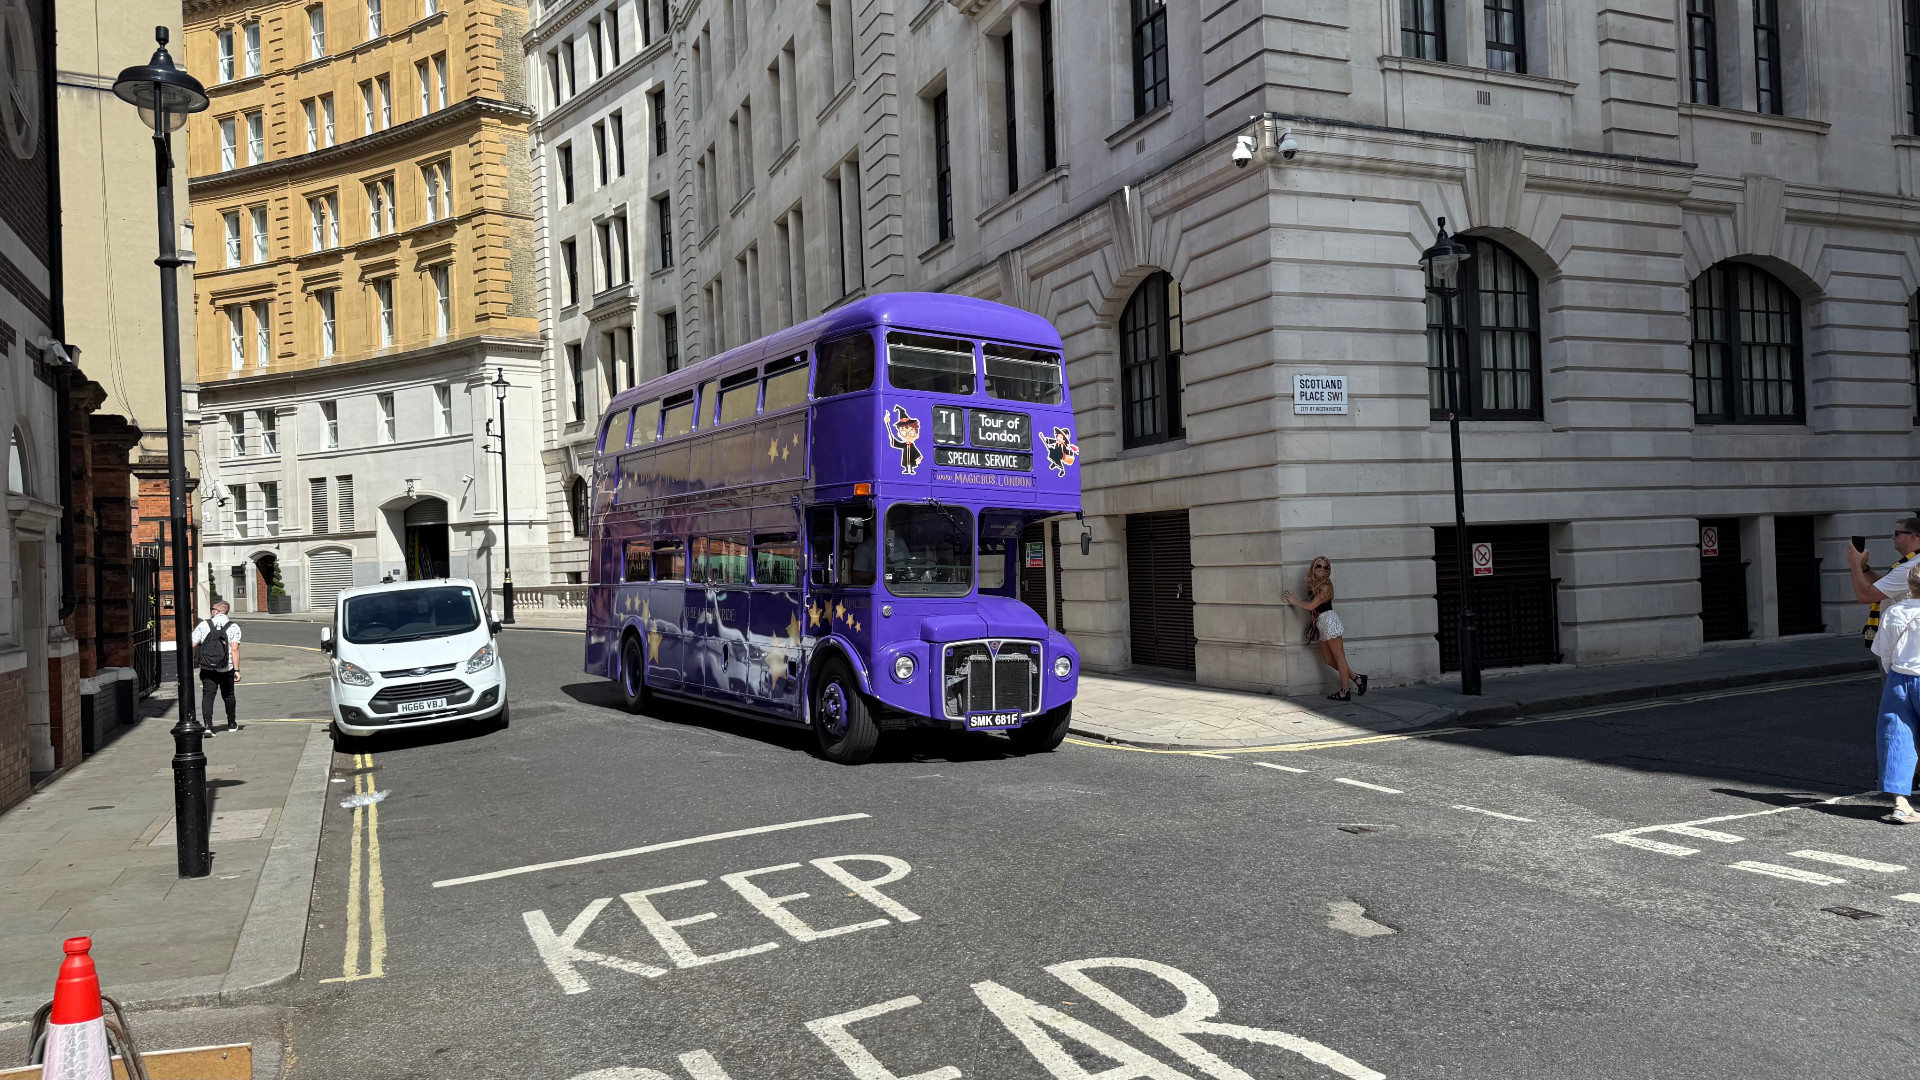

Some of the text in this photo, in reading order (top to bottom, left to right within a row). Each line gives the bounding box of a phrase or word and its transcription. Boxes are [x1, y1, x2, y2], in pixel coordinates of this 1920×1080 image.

[1300, 379, 1342, 389] SCOTLAND
[1300, 391, 1343, 402] PLACE SW1
[978, 414, 1020, 429] Tour of
[978, 428, 1021, 443] London
[947, 451, 1018, 468] SPECIAL SERVICE
[402, 699, 444, 712] HG66 VBJ
[970, 713, 1018, 727] SMK 681F
[522, 854, 921, 995] KEEP
[565, 957, 1388, 1080] EAR
